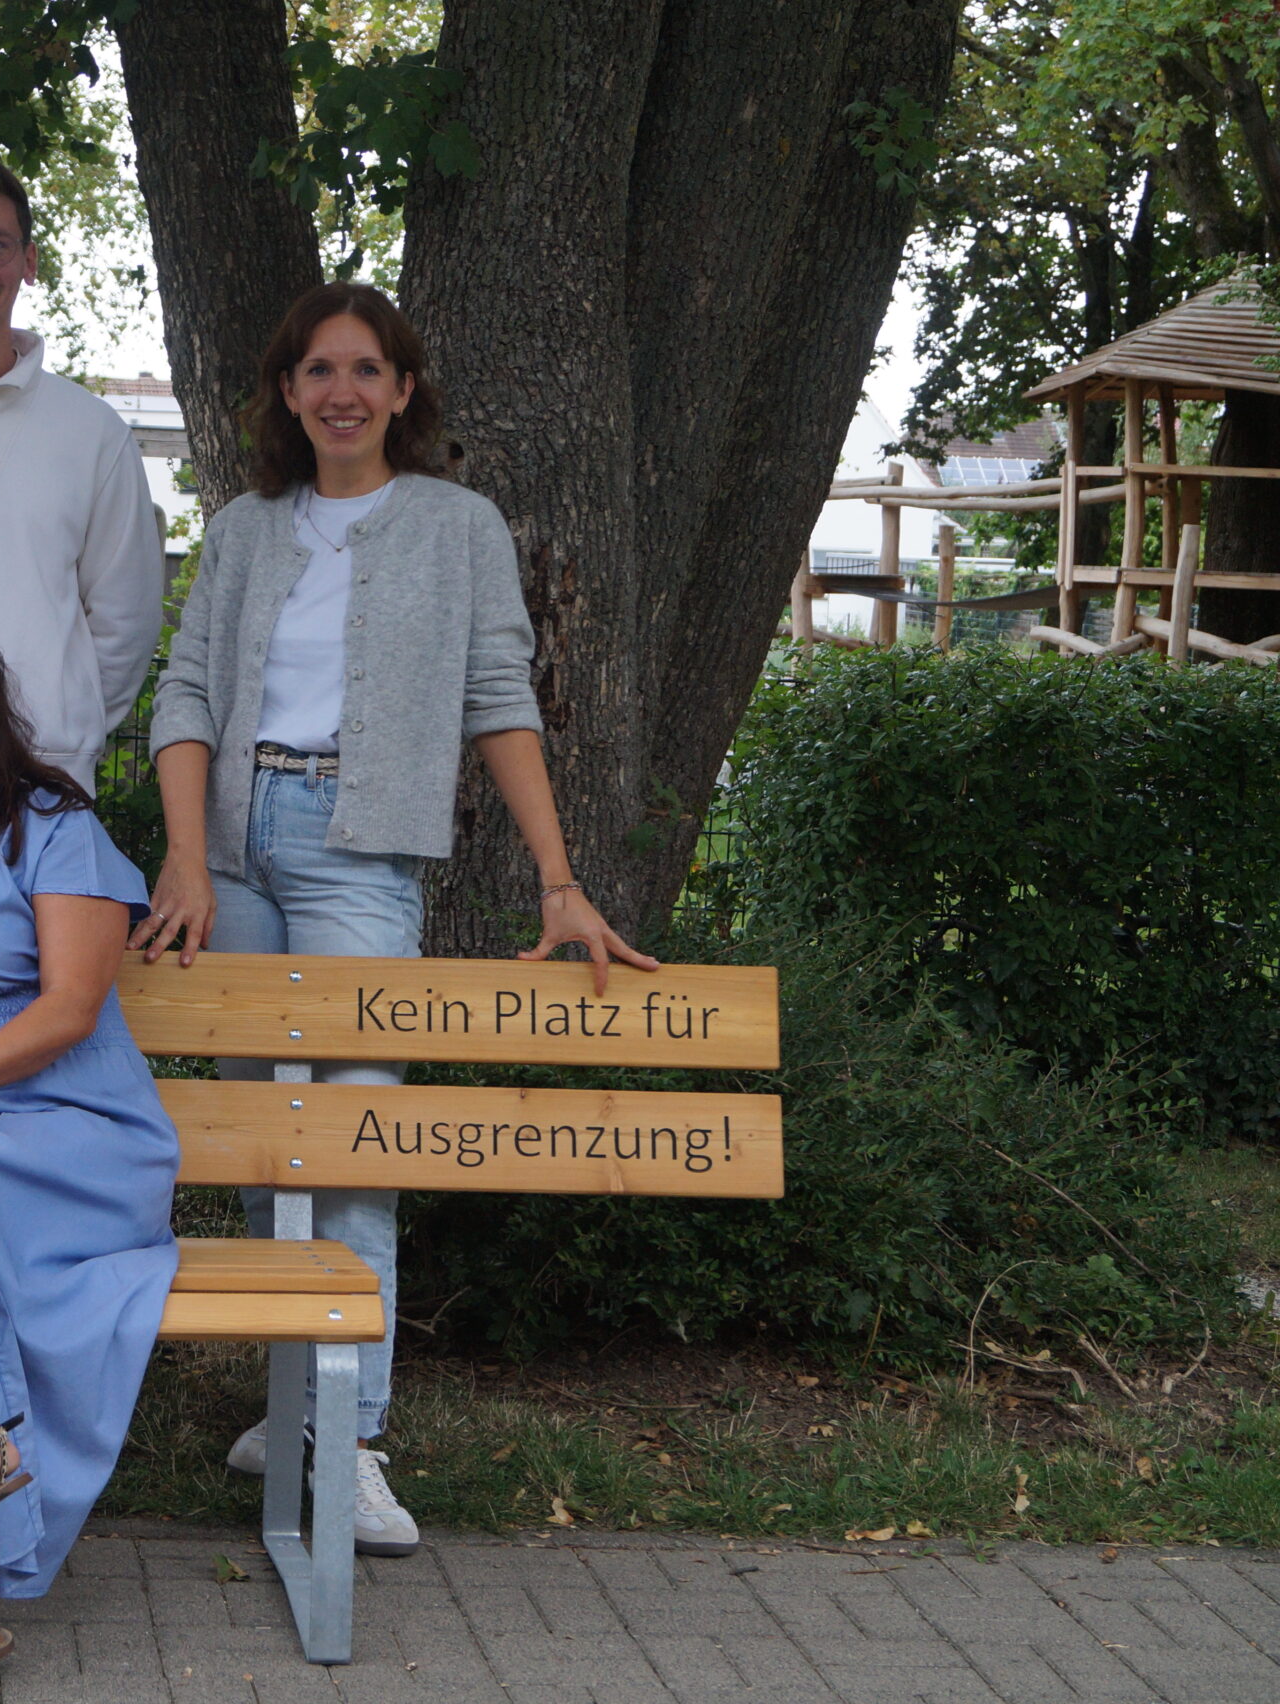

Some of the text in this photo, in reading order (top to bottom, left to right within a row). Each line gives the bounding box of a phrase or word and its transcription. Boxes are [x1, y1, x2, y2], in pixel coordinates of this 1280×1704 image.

[357, 987, 719, 1040] Kein Platz für
[351, 1109, 732, 1174] Ausgrenzung!
